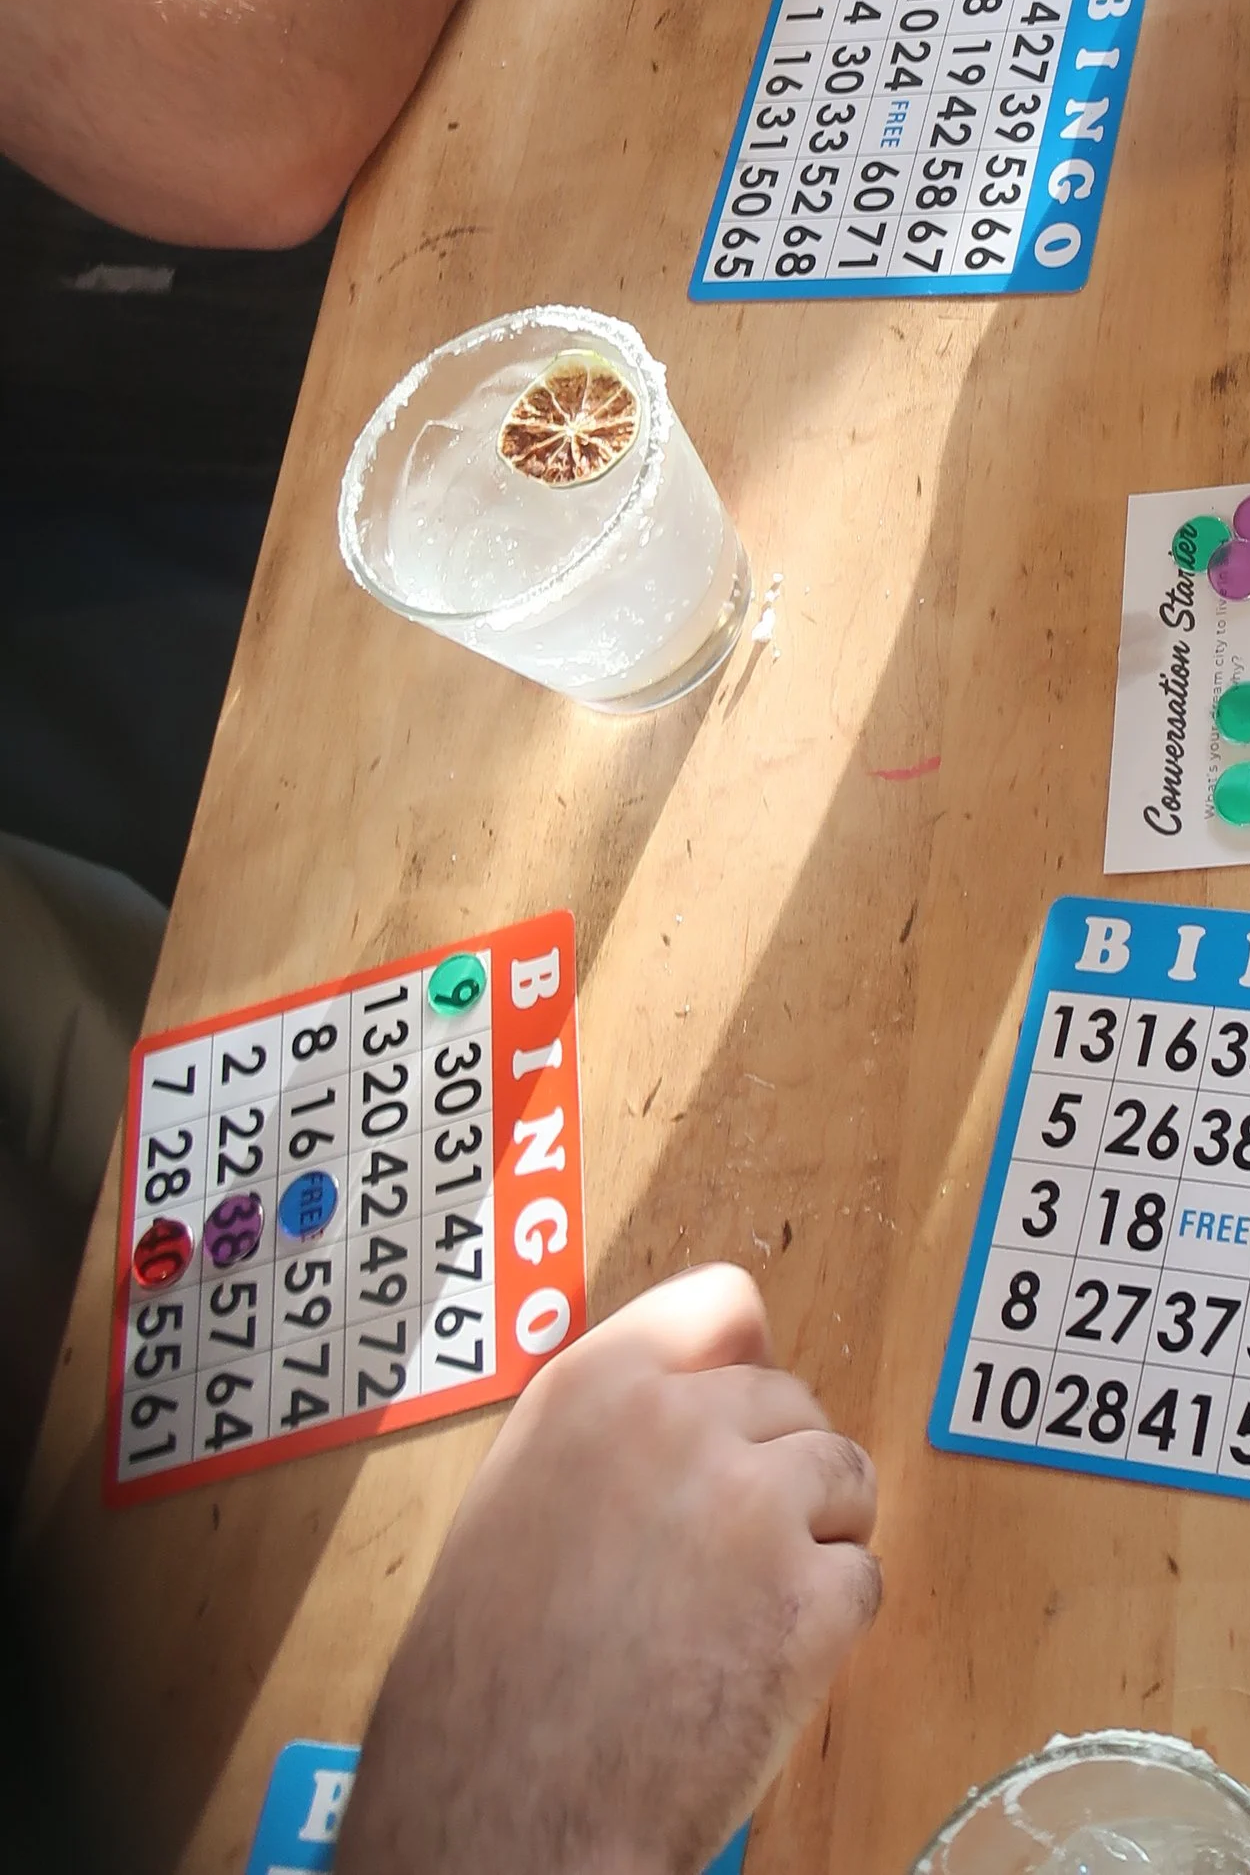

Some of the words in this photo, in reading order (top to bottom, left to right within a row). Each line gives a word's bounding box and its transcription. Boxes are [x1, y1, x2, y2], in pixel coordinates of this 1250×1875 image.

[884, 41, 931, 92] 24
[946, 39, 992, 86] 19
[1009, 34, 1055, 83] 27
[879, 100, 910, 149] FREE
[929, 96, 977, 148] 42
[994, 93, 1041, 143] 39
[853, 161, 900, 212] 60
[915, 157, 964, 210] 58
[979, 154, 1027, 207] 53
[837, 222, 887, 268] 71
[902, 220, 948, 273] 67
[964, 218, 1012, 270] 66
[1158, 521, 1198, 633] Starter
[1213, 639, 1227, 666] city
[1216, 619, 1226, 634] to
[1143, 639, 1193, 836] Conversation
[1208, 726, 1222, 760] your
[1203, 764, 1218, 819] What's
[362, 985, 409, 1056] 13
[433, 977, 481, 1010] 9
[291, 1024, 338, 1061] 8
[1053, 1005, 1117, 1063] 13
[1137, 1013, 1198, 1072] 16
[151, 1065, 196, 1095] 7
[361, 1063, 408, 1138] 20
[434, 1042, 482, 1116] 30
[288, 1088, 335, 1160] 16
[508, 945, 573, 1357] BINGO
[144, 1130, 193, 1205] 28
[361, 1151, 408, 1227] 42
[434, 1124, 483, 1194] 31
[435, 1212, 483, 1281] 47
[1022, 1180, 1060, 1238] 3
[1099, 1188, 1166, 1252] 18
[284, 1260, 332, 1329] 59
[359, 1236, 408, 1307] 49
[133, 1303, 184, 1380] 55
[434, 1306, 484, 1373] 67
[1001, 1270, 1041, 1331] 8
[1065, 1279, 1152, 1345] 27
[1157, 1291, 1242, 1357] 37
[280, 1342, 330, 1430] 74
[357, 1320, 406, 1408] 72
[127, 1394, 178, 1466] 61
[972, 1362, 1041, 1430] 10
[1045, 1374, 1129, 1444] 28
[1137, 1388, 1212, 1457] 41
